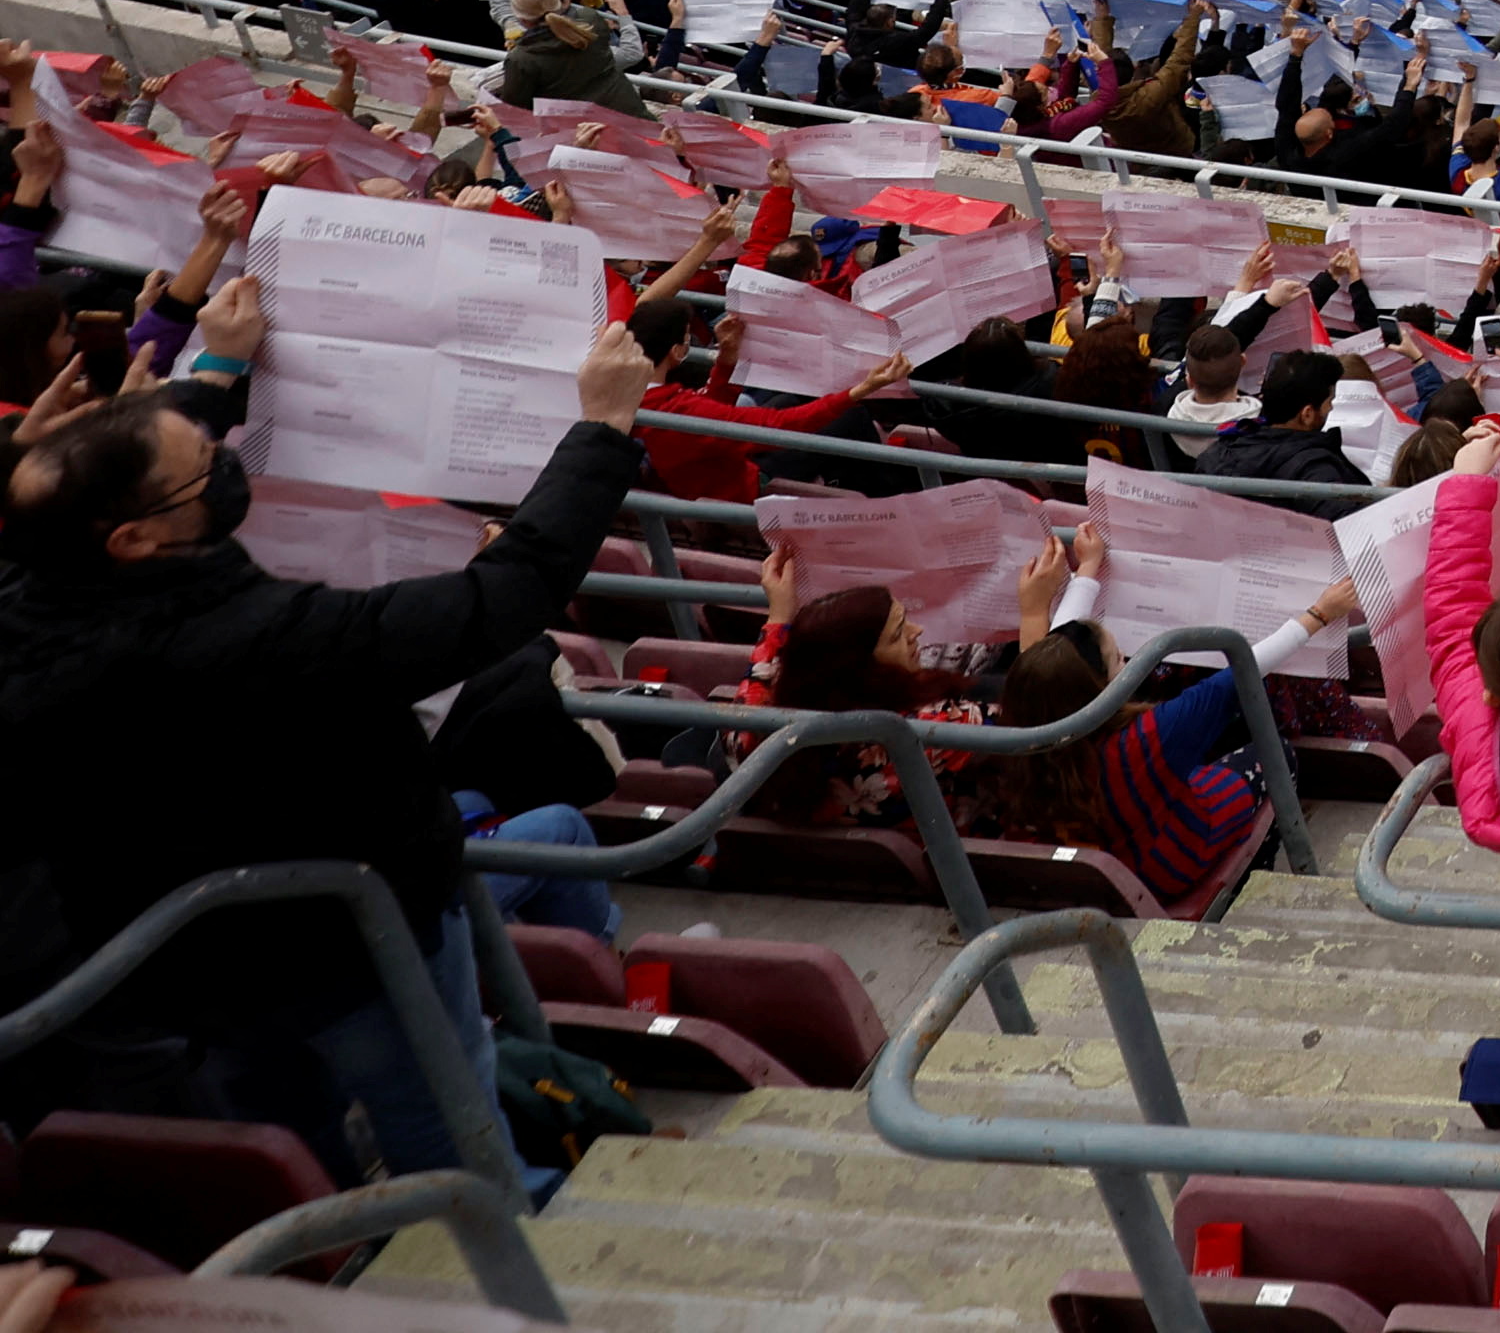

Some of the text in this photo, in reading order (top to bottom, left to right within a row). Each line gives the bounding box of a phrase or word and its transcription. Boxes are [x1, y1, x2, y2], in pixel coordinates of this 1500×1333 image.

[324, 222, 426, 249] FC BARCELONA
[1130, 487, 1198, 509] FC BARCELONA
[812, 513, 897, 523] FC BARCELONA
